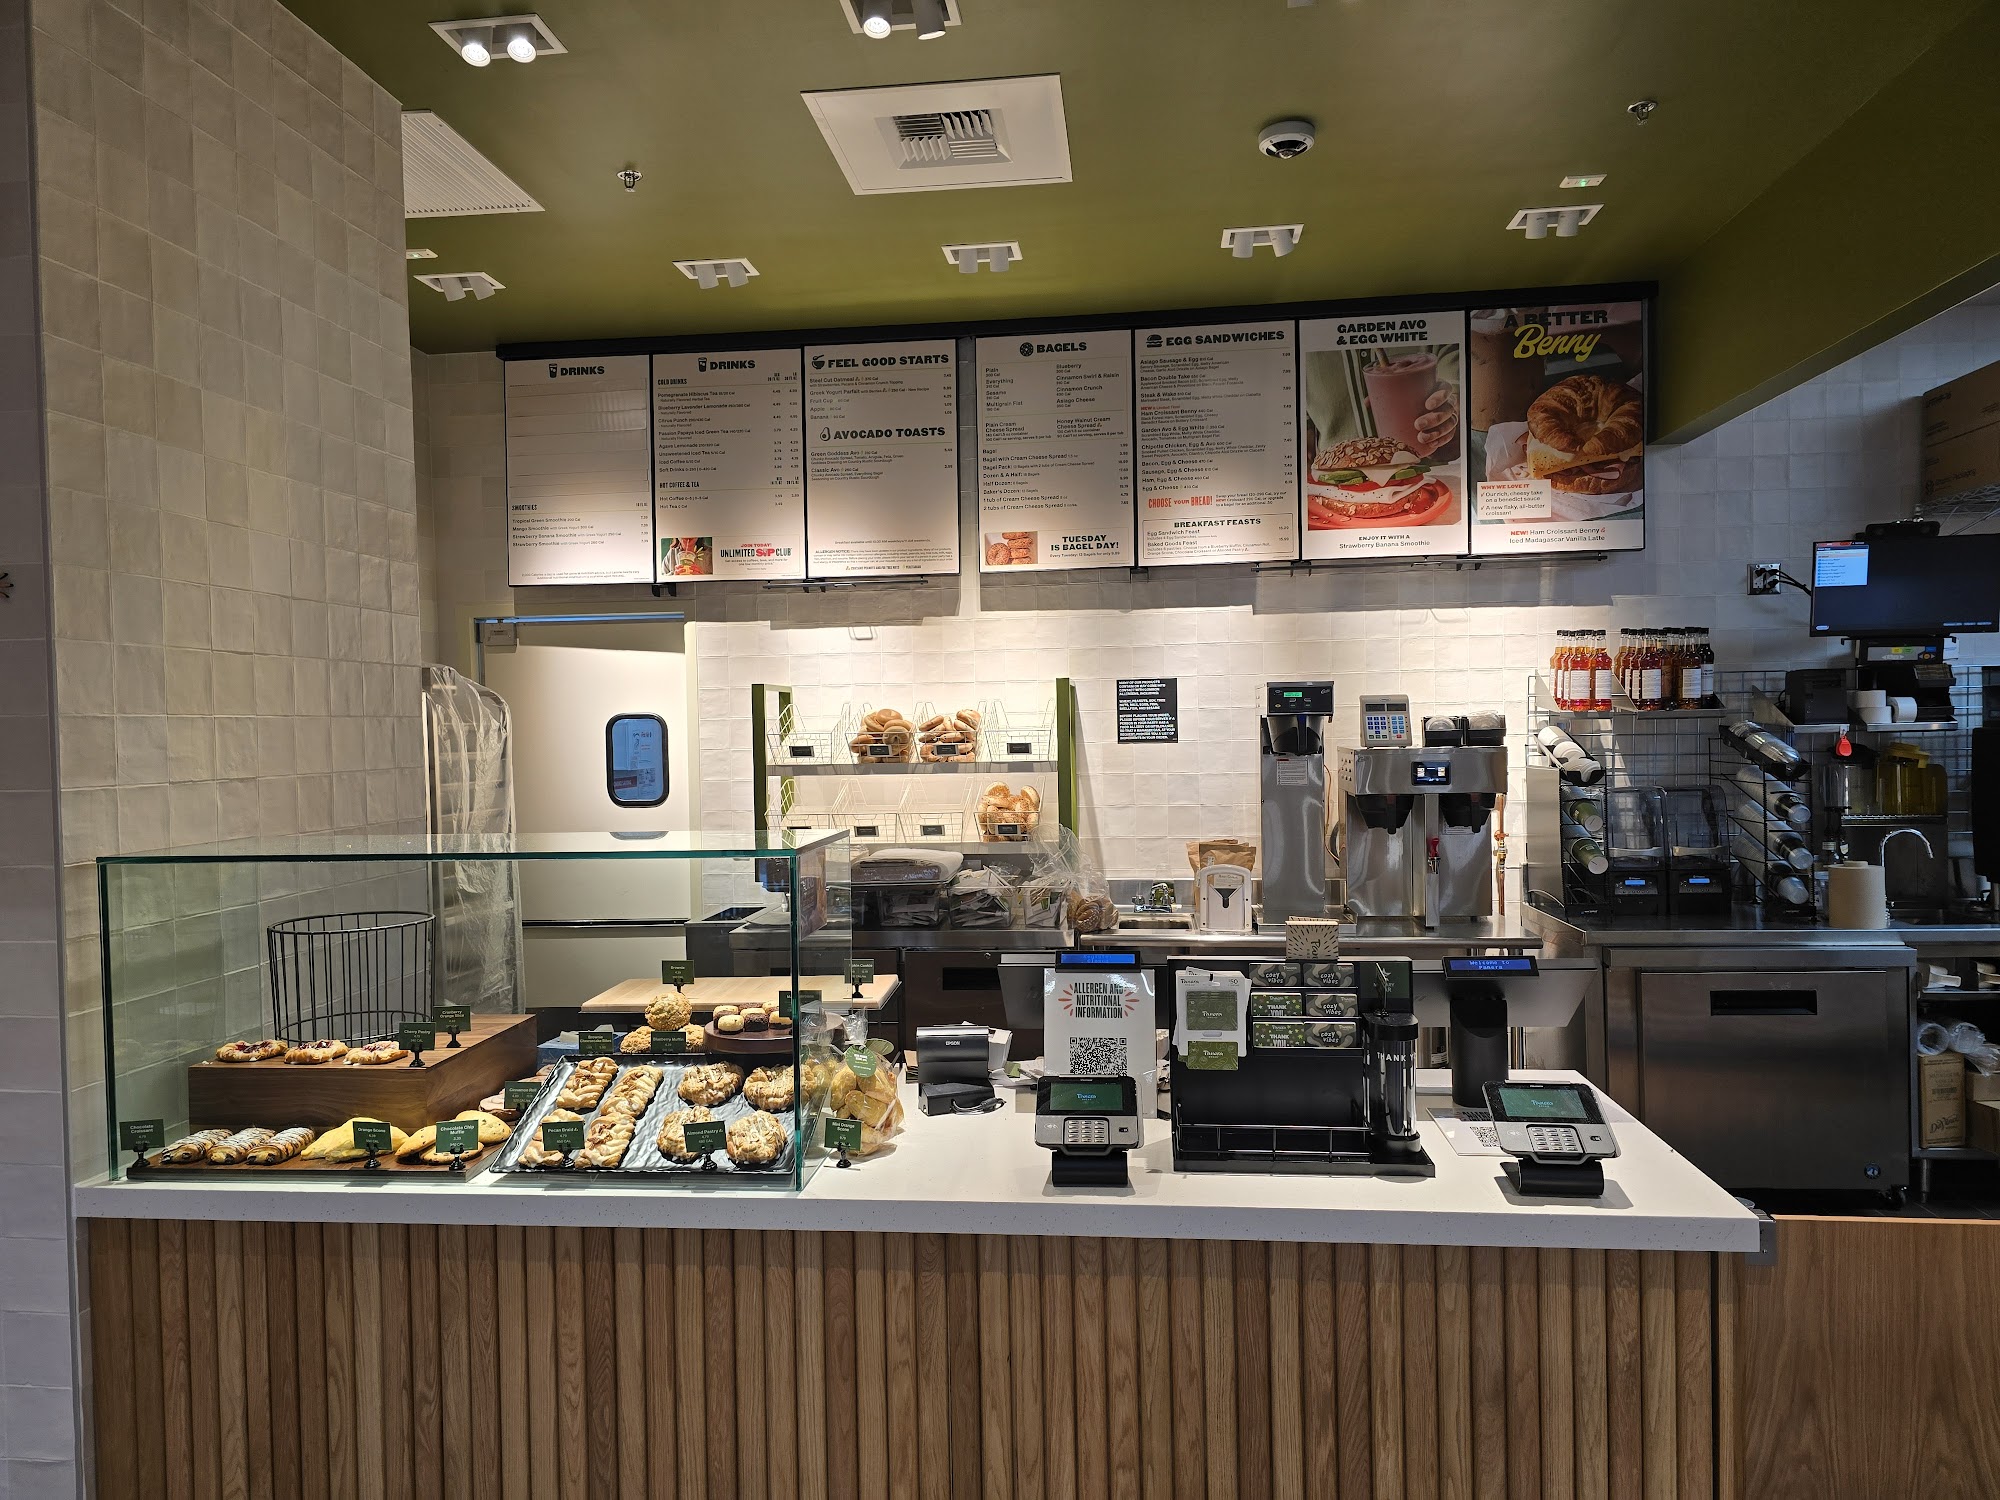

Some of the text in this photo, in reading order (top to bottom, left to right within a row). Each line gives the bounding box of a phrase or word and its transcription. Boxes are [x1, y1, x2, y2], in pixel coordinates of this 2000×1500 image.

[1504, 310, 1608, 328] A BETTER
[1337, 320, 1426, 333] GARDEN AVO
[1166, 331, 1285, 346] EGG SANDWICHES
[1337, 332, 1427, 345] & EGG WHITE
[1514, 324, 1601, 362] Benny
[1037, 342, 1087, 353] BAGELS
[710, 360, 755, 370] DRINKS
[828, 355, 948, 368] FEEL GOOD STARTS
[561, 366, 604, 376] DRINKS
[834, 427, 945, 439] AVOCADO TOASTS
[1149, 498, 1171, 508] CHOOSE
[1191, 496, 1212, 506] BREAD!
[1174, 518, 1261, 528] BREAKFAST FEASTS
[721, 549, 754, 558] UNLIMITED
[1074, 983, 1123, 994] ALLERGEN AND
[1077, 995, 1121, 1006] NUTRITIONAL
[1076, 1007, 1122, 1018] INFORMATION
[1377, 1052, 1406, 1062] THANK
